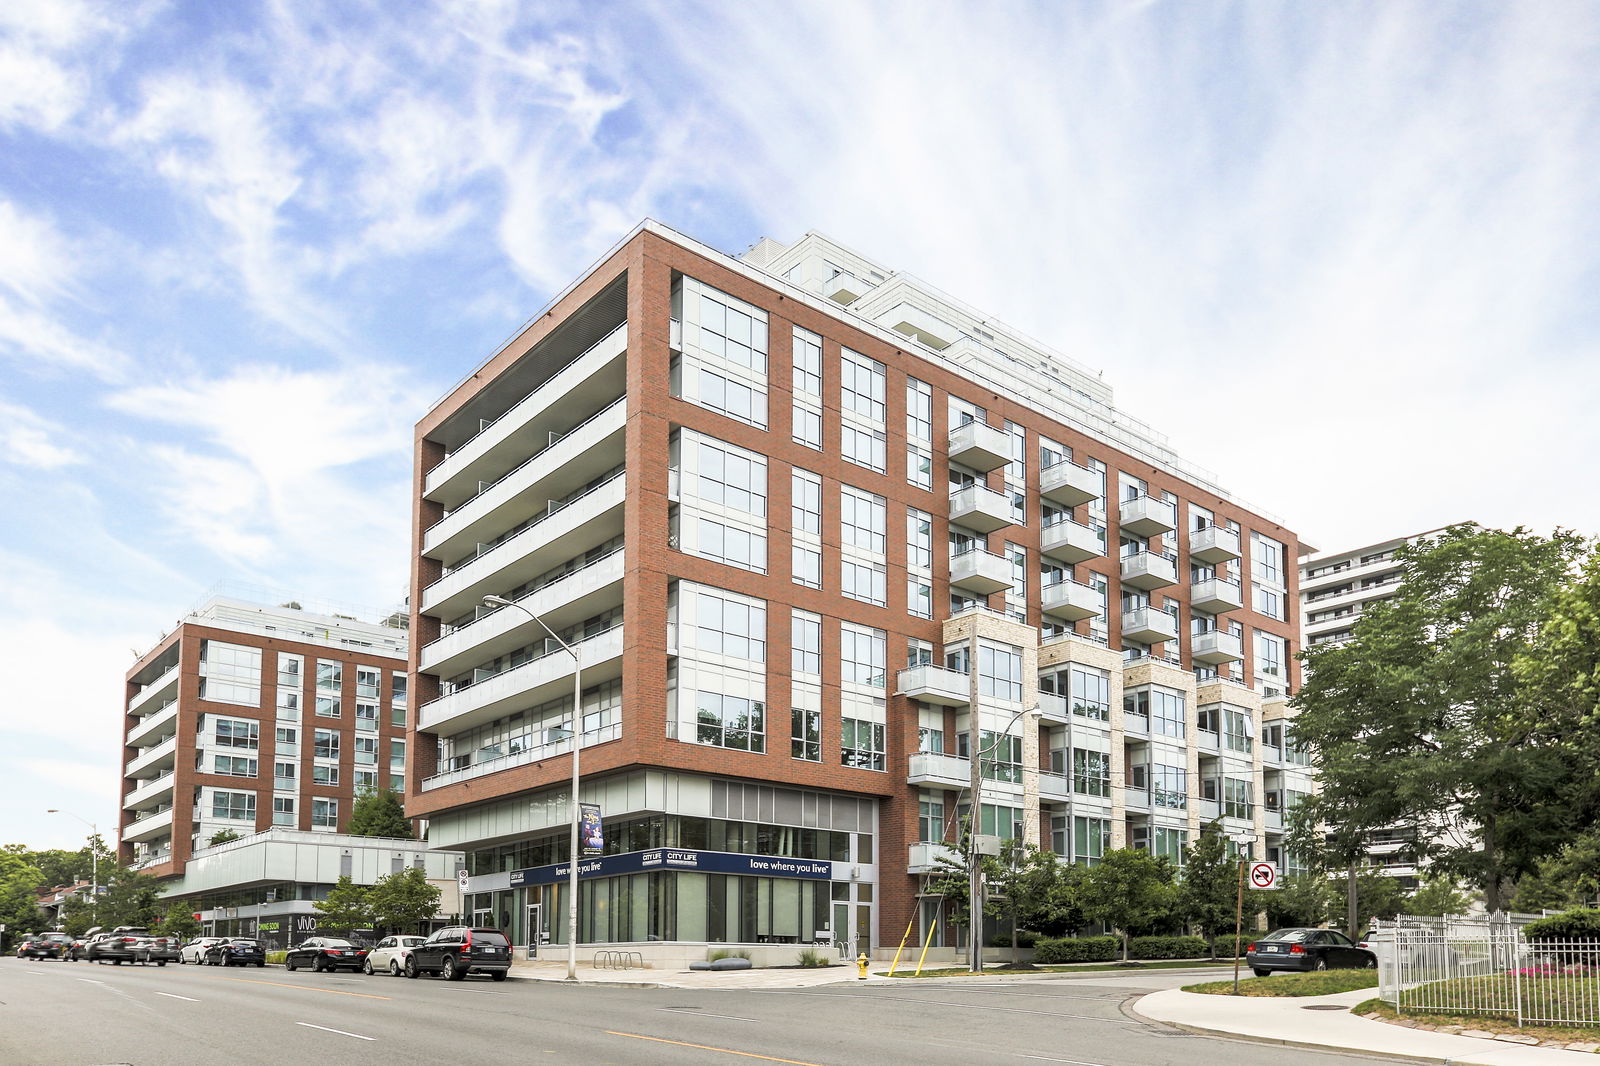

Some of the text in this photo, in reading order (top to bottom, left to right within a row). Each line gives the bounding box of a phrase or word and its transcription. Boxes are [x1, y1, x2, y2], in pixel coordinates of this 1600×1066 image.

[556, 868, 566, 876] love
[581, 865, 590, 875] you
[750, 859, 768, 869] love
[770, 861, 795, 871] where
[797, 864, 810, 874] you
